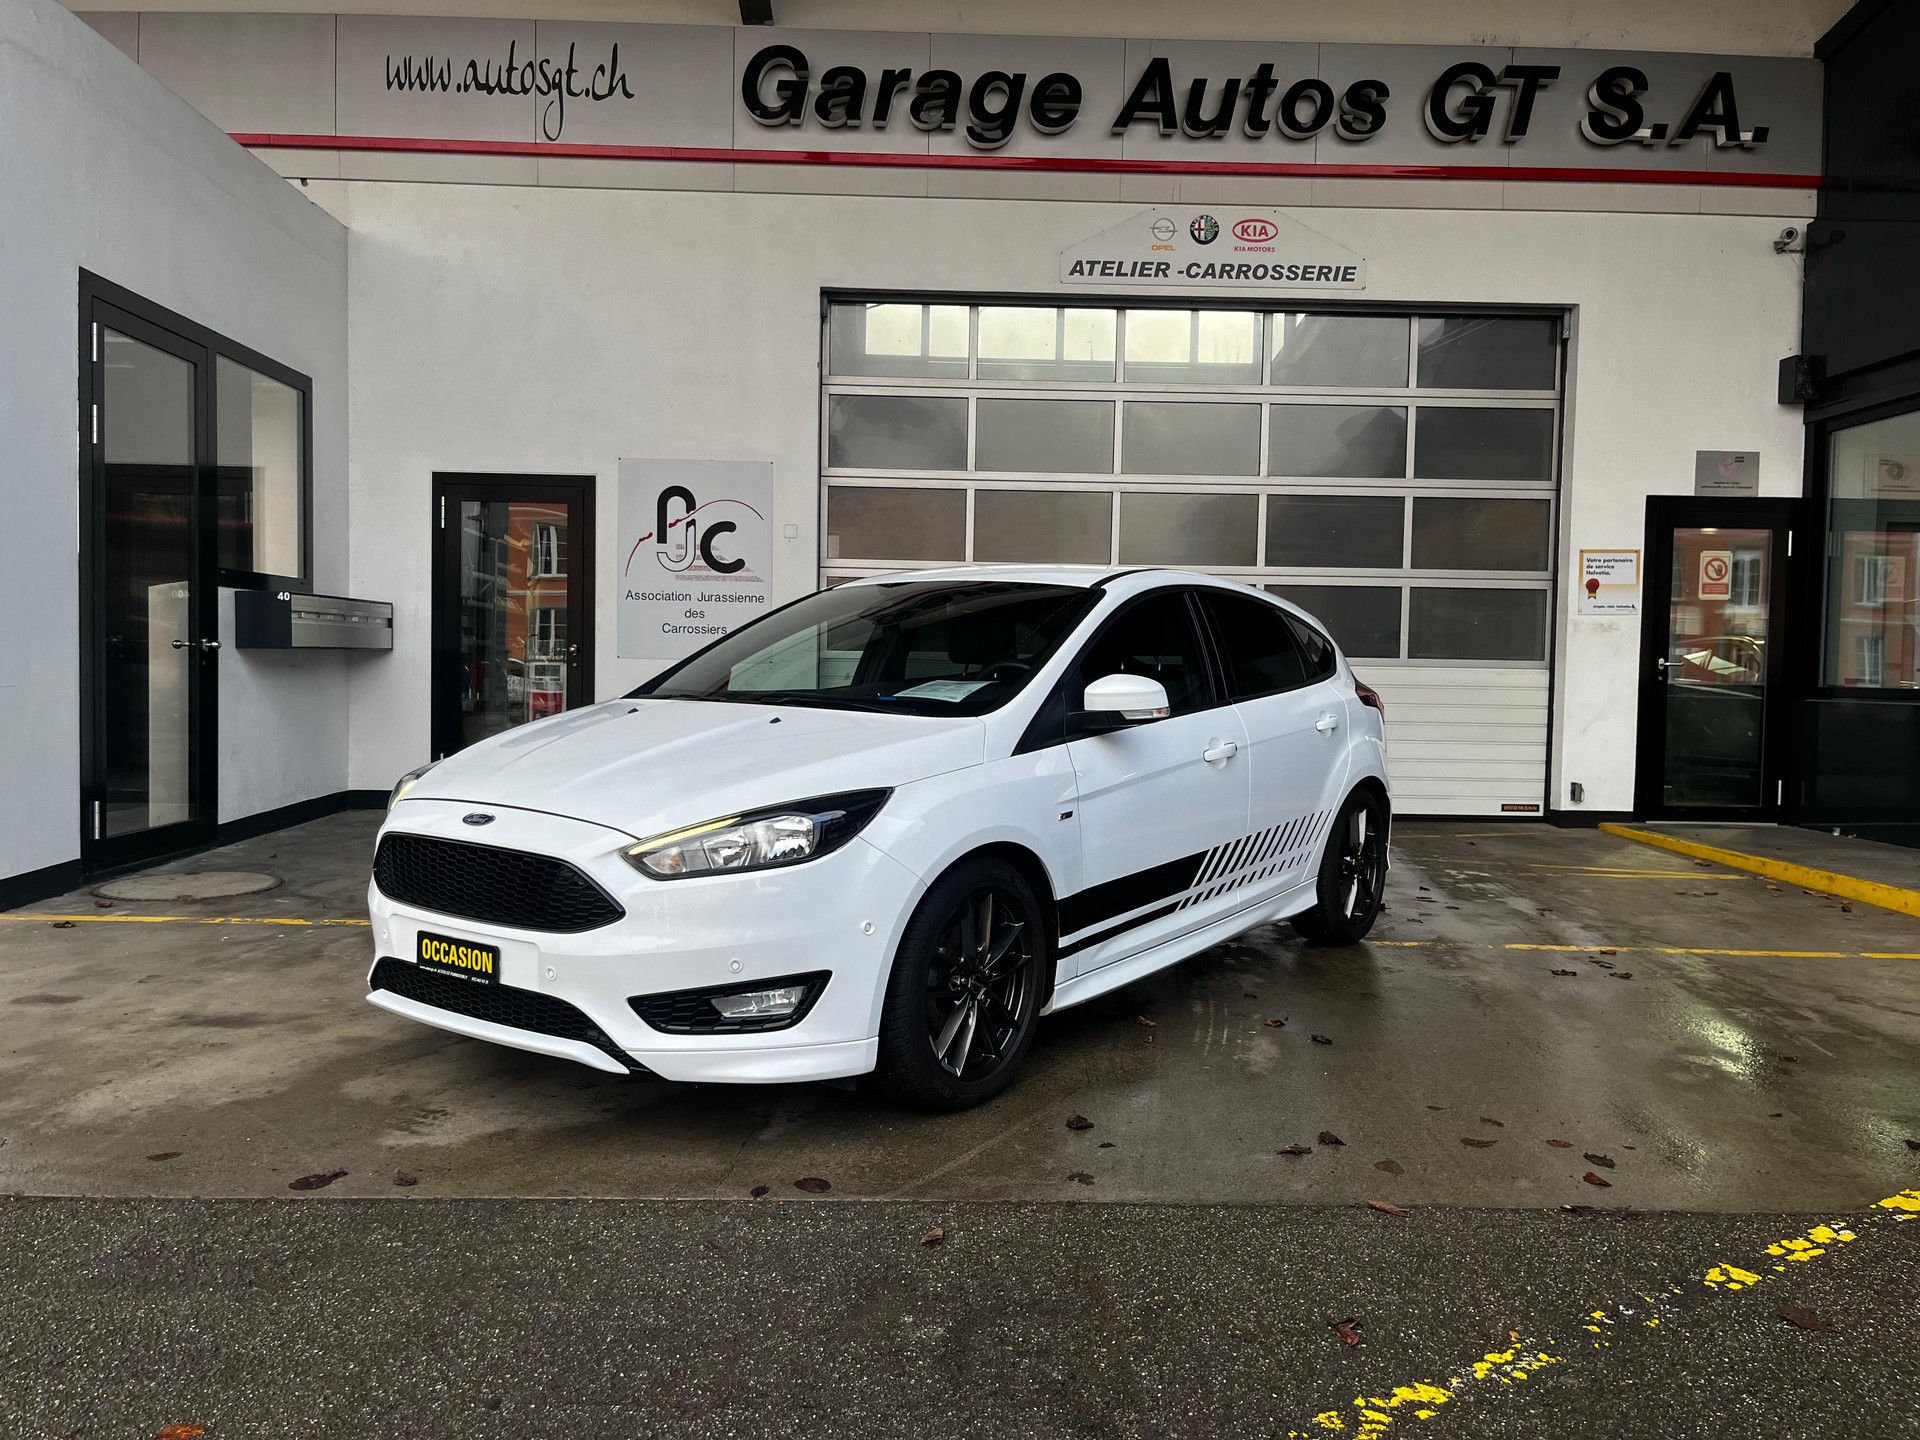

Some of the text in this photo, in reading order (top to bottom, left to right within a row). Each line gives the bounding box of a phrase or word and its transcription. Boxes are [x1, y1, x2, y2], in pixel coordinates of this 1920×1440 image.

[386, 39, 635, 142] www.autosgt.ch
[741, 44, 1770, 149] Garage Autos GT S.A.
[1240, 224, 1269, 238] KIA
[1151, 244, 1176, 252] OPEL
[1068, 260, 1357, 283] ATELIER -CARROSSERIE
[277, 592, 290, 601] 40
[626, 590, 765, 603] Association Jurassienne
[684, 608, 705, 618] des
[661, 623, 728, 635] Carrossiers
[422, 939, 493, 974] OCCASION
